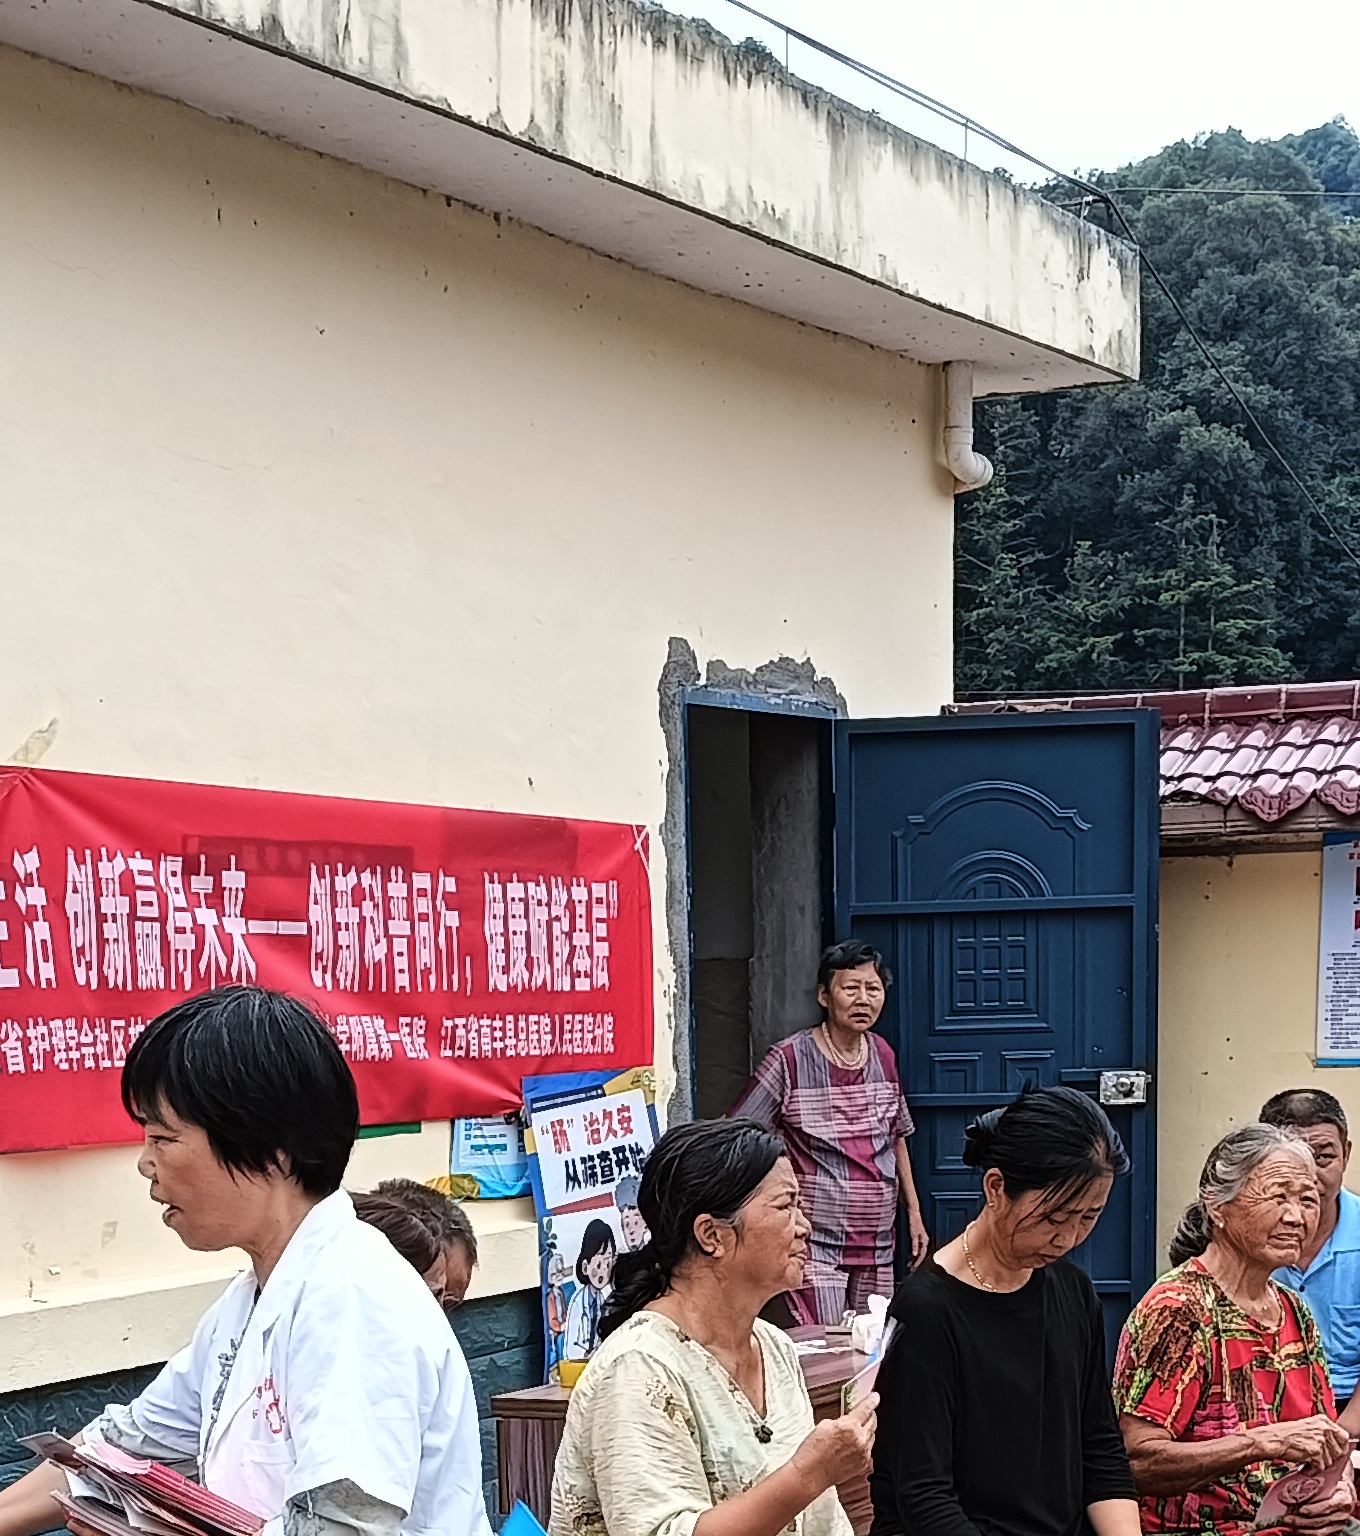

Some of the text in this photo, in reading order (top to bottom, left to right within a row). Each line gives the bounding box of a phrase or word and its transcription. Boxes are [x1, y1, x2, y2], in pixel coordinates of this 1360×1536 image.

[328, 1014, 430, 1062] 学附属第一医院
[440, 1012, 615, 1059] 江西省南丰县总医院人民医院分院
